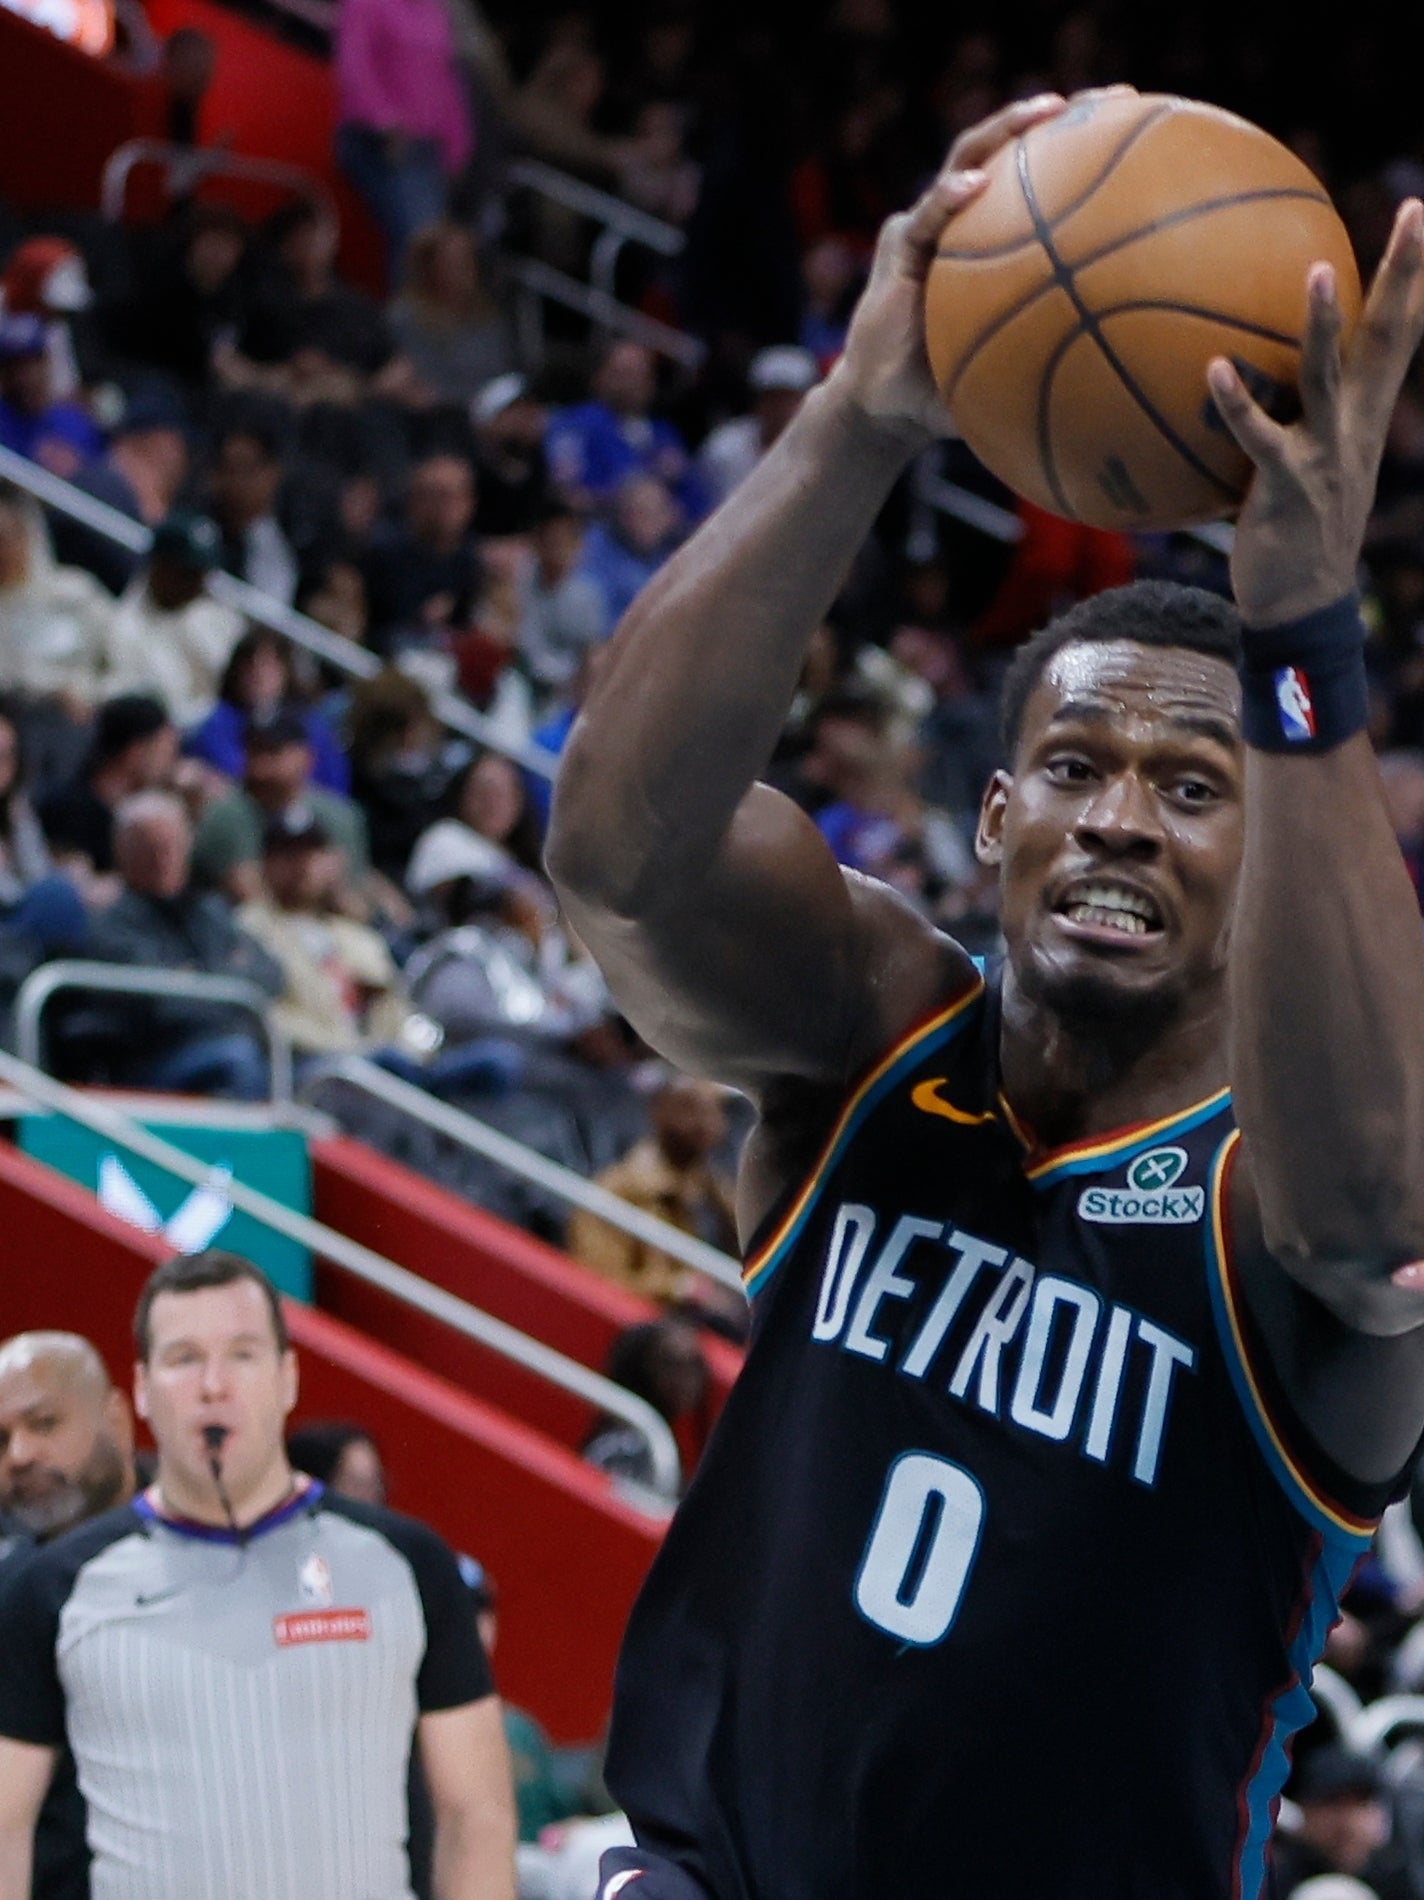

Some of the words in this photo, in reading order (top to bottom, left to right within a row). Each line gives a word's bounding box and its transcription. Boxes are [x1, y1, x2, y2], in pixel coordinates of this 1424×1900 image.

[1085, 1192, 1200, 1218] StockX
[811, 1201, 1197, 1487] DETROIT
[853, 1450, 987, 1648] 0
